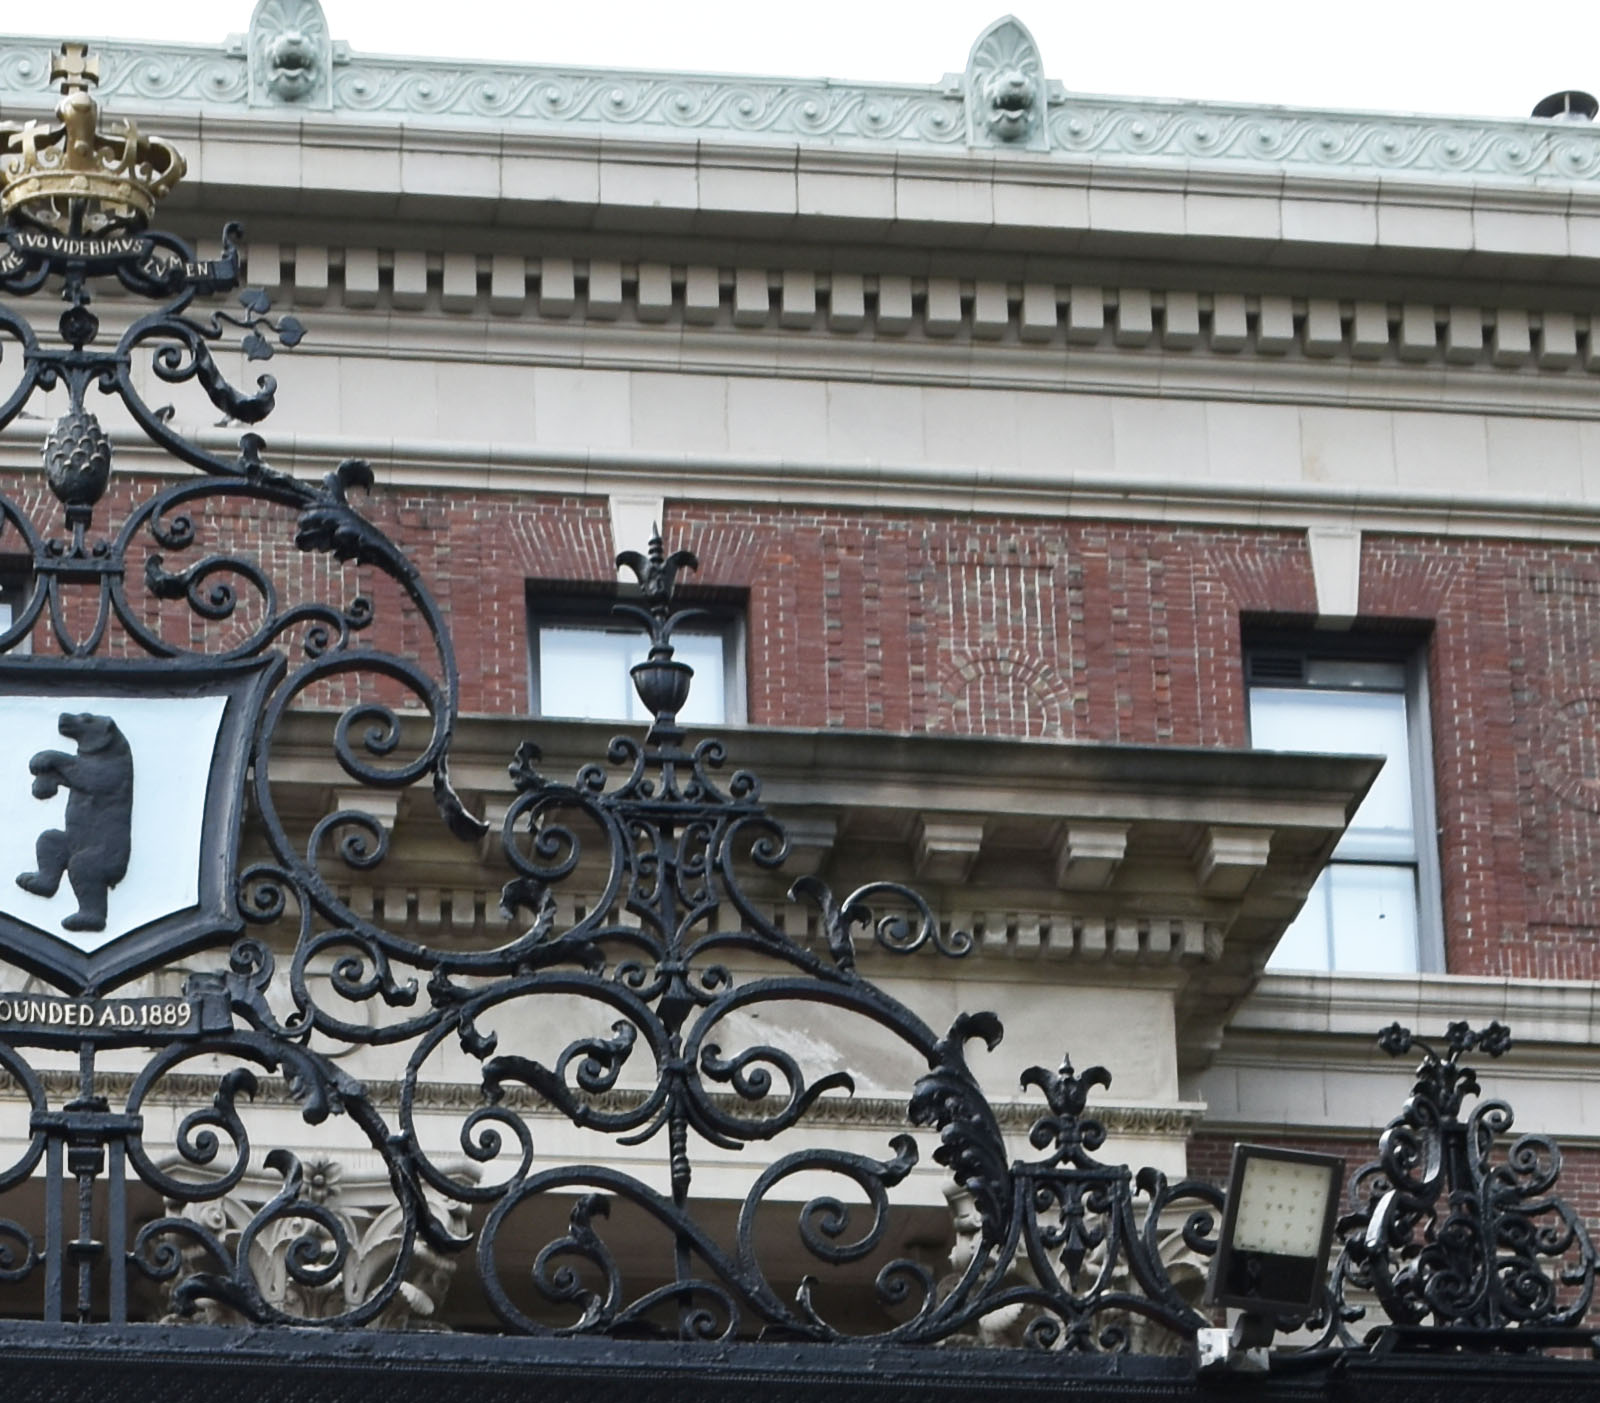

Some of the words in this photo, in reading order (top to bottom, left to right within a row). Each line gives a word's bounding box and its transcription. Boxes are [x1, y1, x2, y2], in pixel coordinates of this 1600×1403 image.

[15, 233, 48, 247] TVO
[52, 236, 144, 256] VIDEBIMVS
[144, 255, 208, 278] LVMEN
